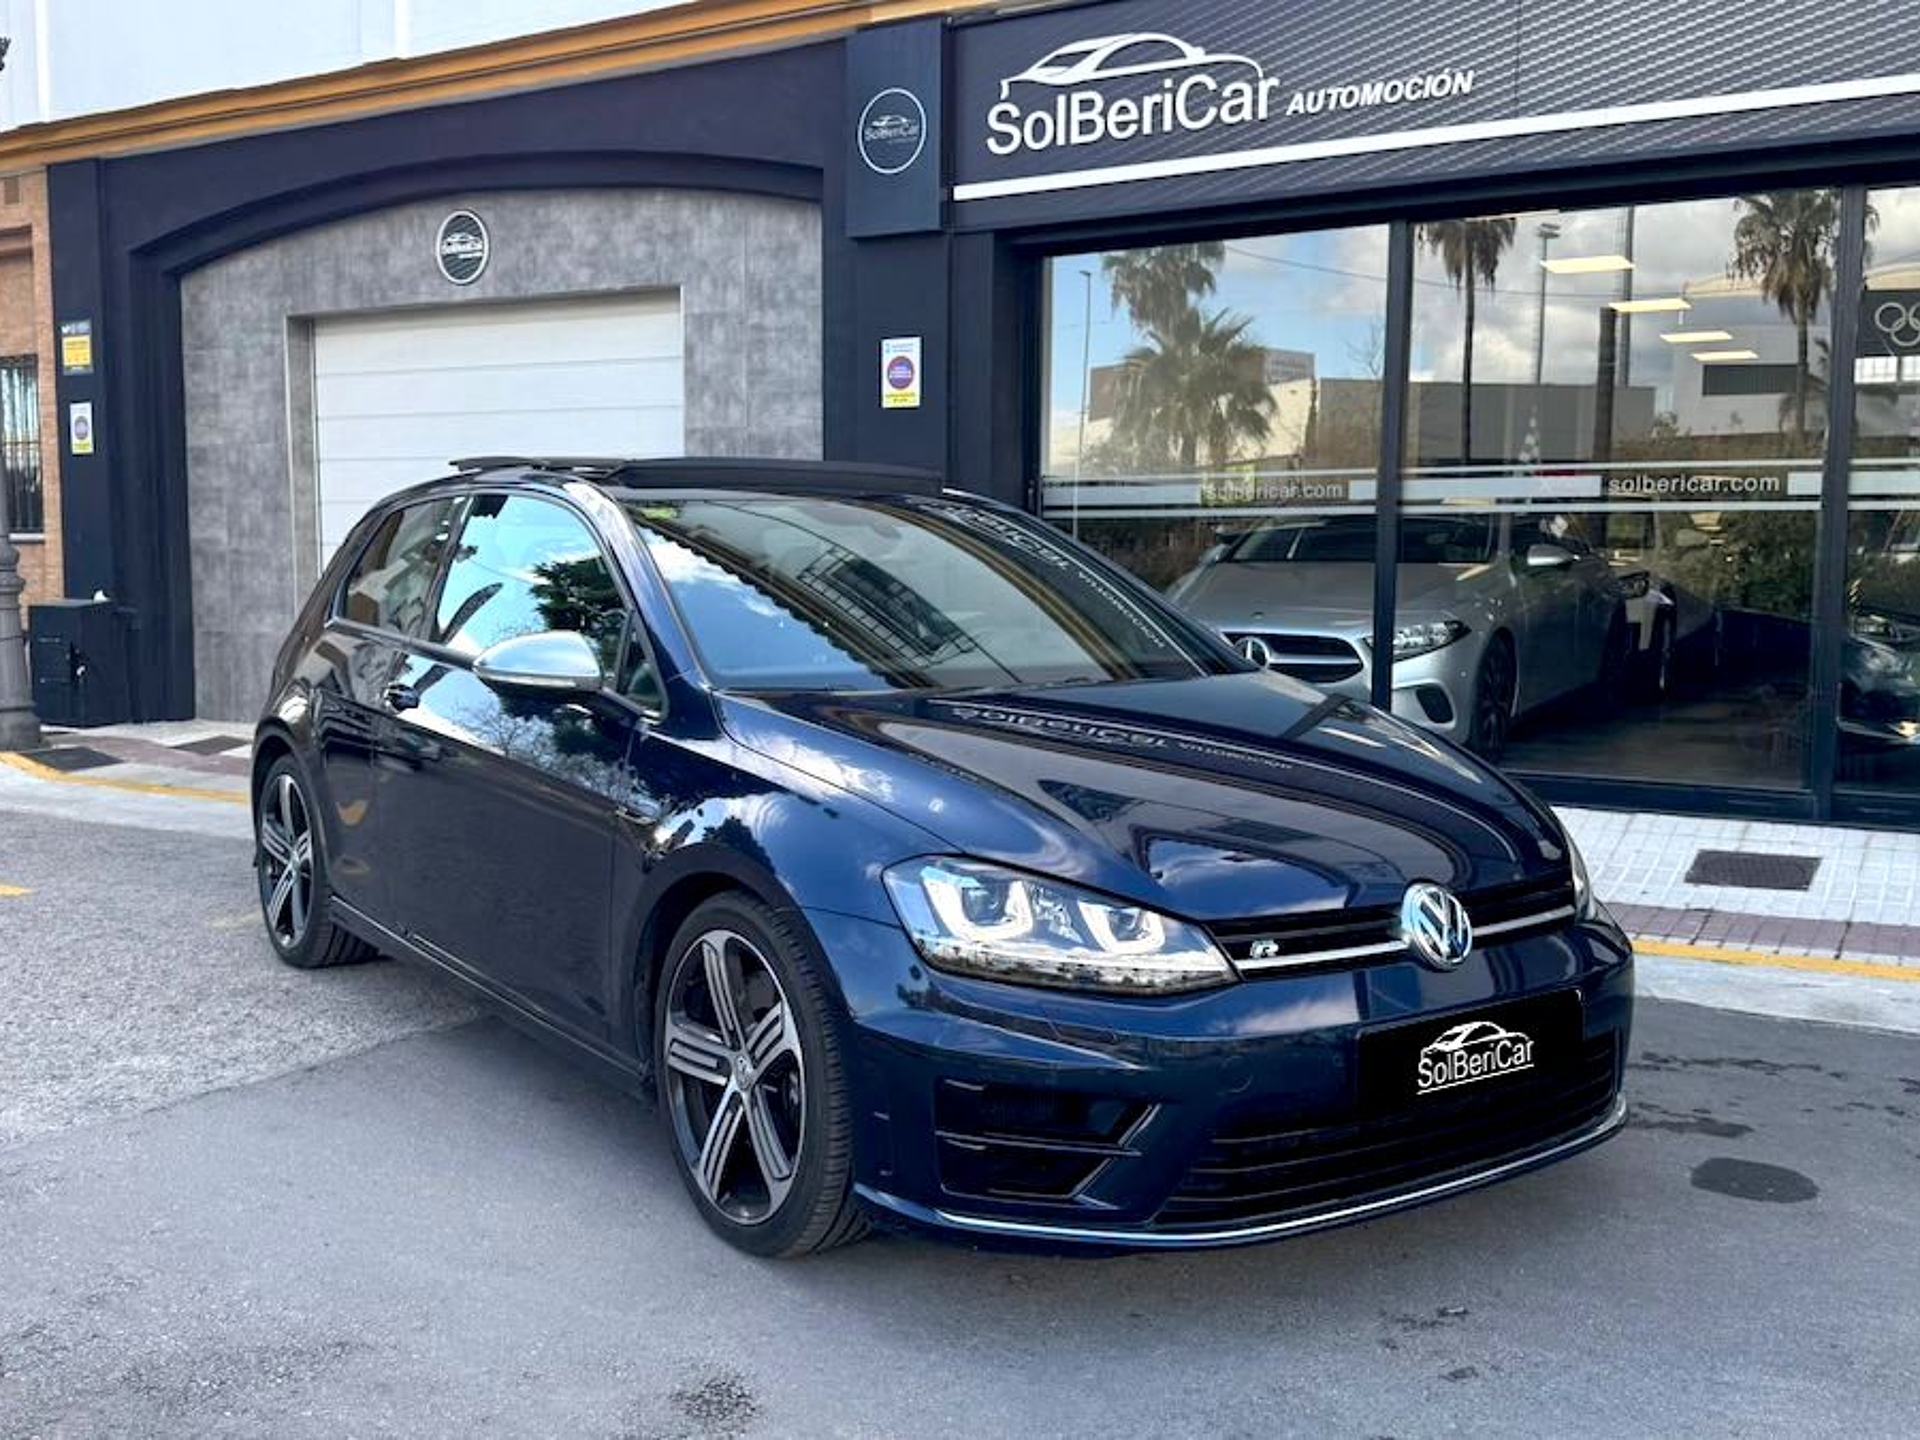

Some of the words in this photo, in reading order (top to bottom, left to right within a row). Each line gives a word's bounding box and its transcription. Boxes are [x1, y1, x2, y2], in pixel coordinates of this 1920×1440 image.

[986, 73, 1280, 154] SolBeriCar
[1286, 68, 1475, 116] AUTOMOCIÓN
[1205, 480, 1343, 500] solbericar.com
[1607, 474, 1781, 493] solbericar.com
